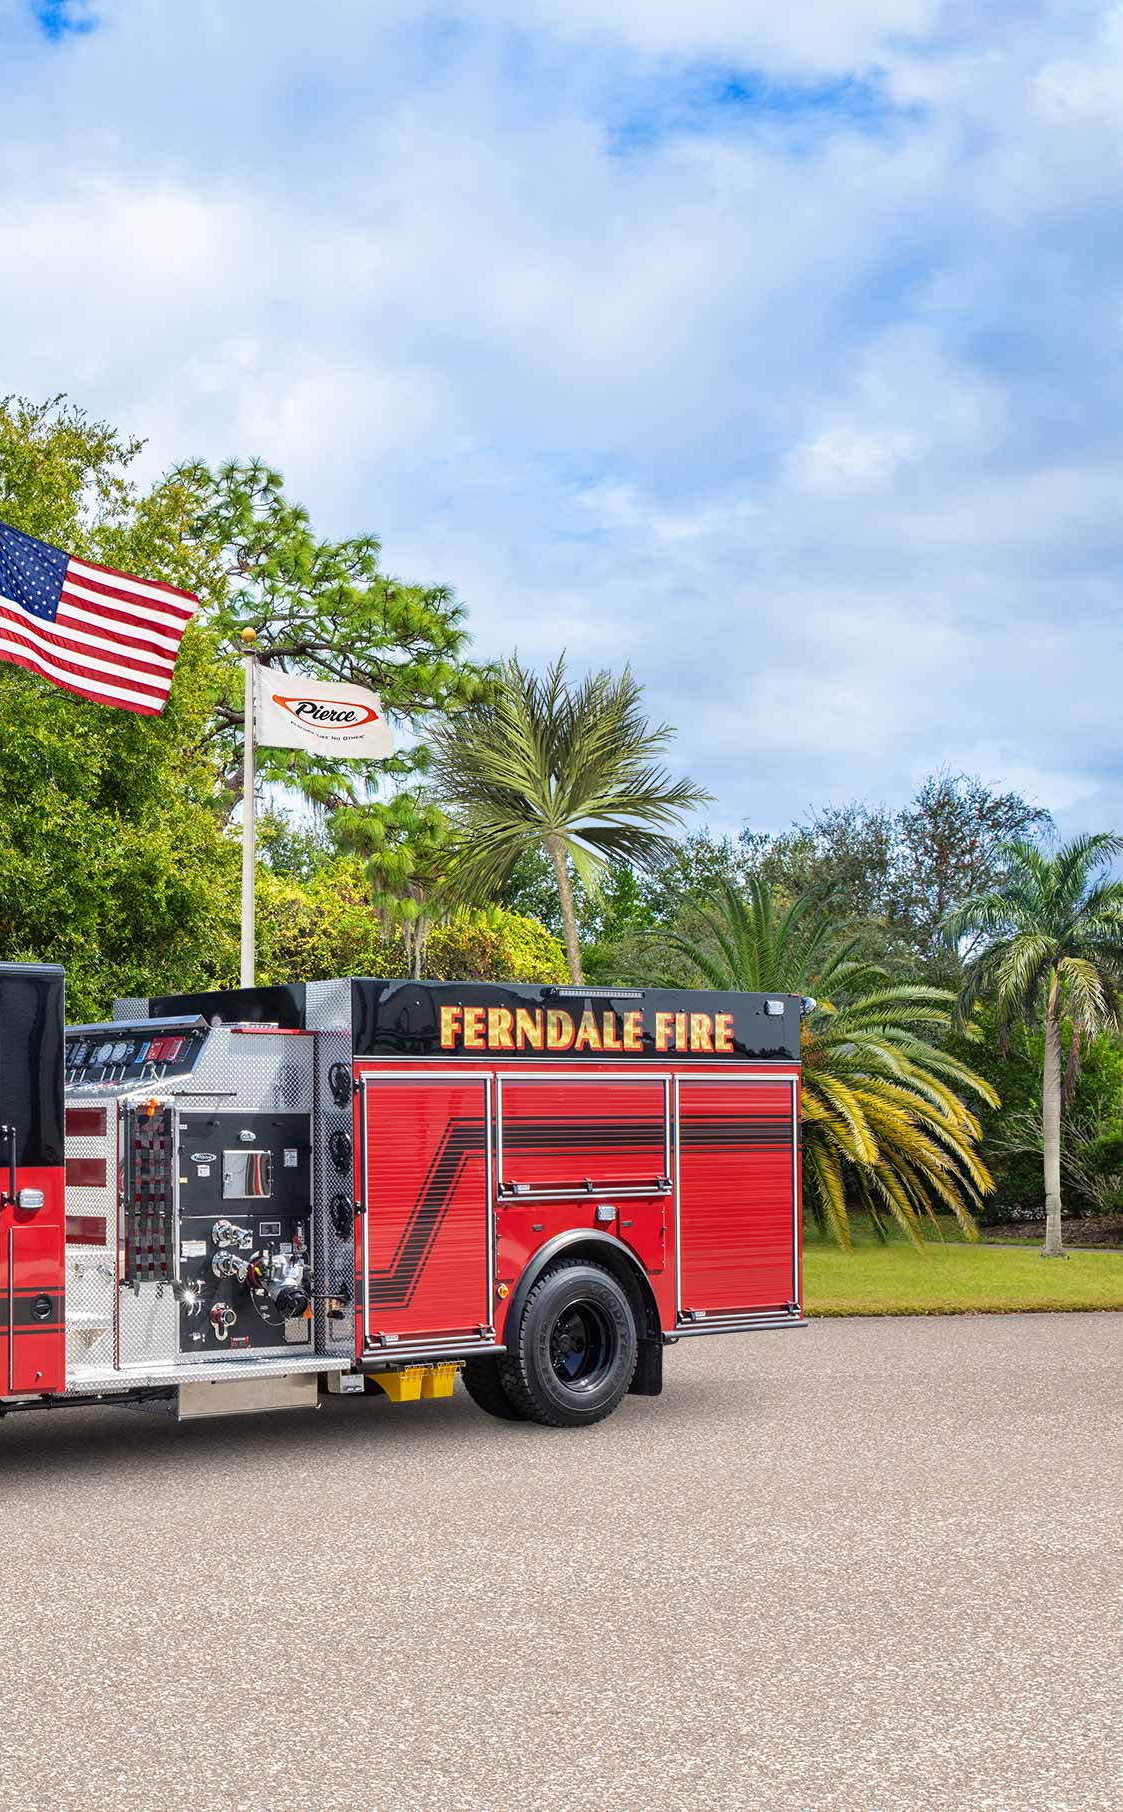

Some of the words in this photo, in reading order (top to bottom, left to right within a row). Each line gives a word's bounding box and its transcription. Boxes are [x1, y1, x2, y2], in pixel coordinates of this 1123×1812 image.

[295, 701, 355, 722] Pierce
[440, 1005, 644, 1051] FERNDALE
[655, 1011, 734, 1053] FIRE
